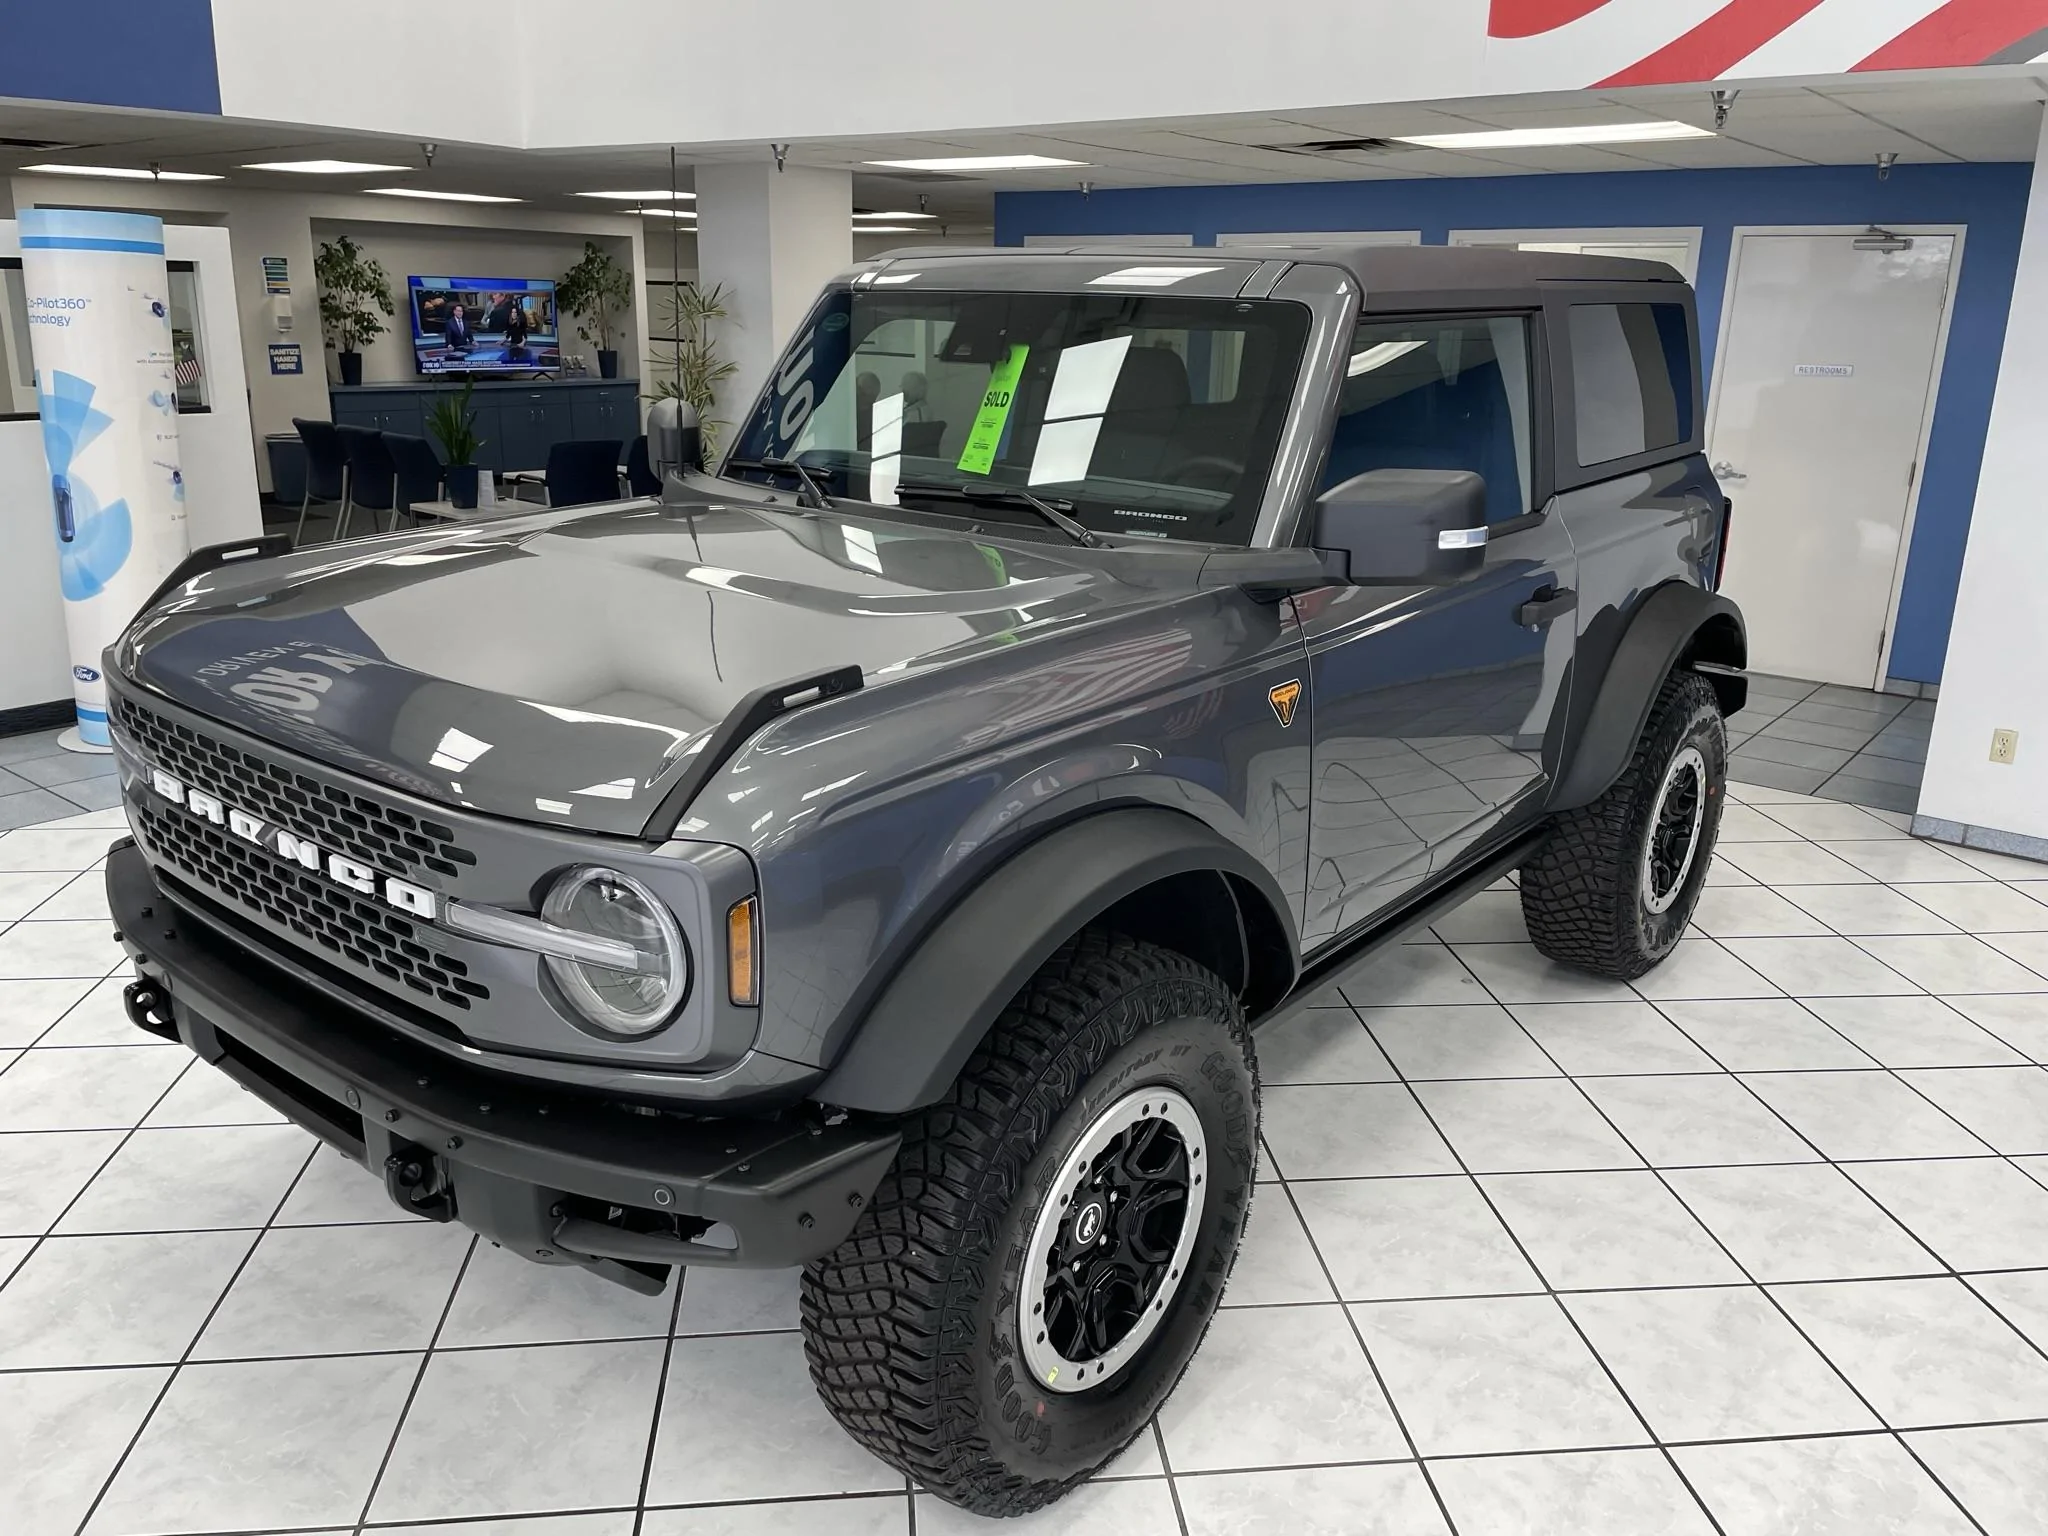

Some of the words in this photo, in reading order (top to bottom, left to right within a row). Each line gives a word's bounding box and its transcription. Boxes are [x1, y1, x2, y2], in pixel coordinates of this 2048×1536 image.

[1798, 366, 1848, 375] RESTROOMS
[984, 391, 1010, 408] SOLD
[1113, 509, 1188, 521] BRONCO
[76, 667, 93, 681] Ford
[151, 768, 437, 920] BRONCO
